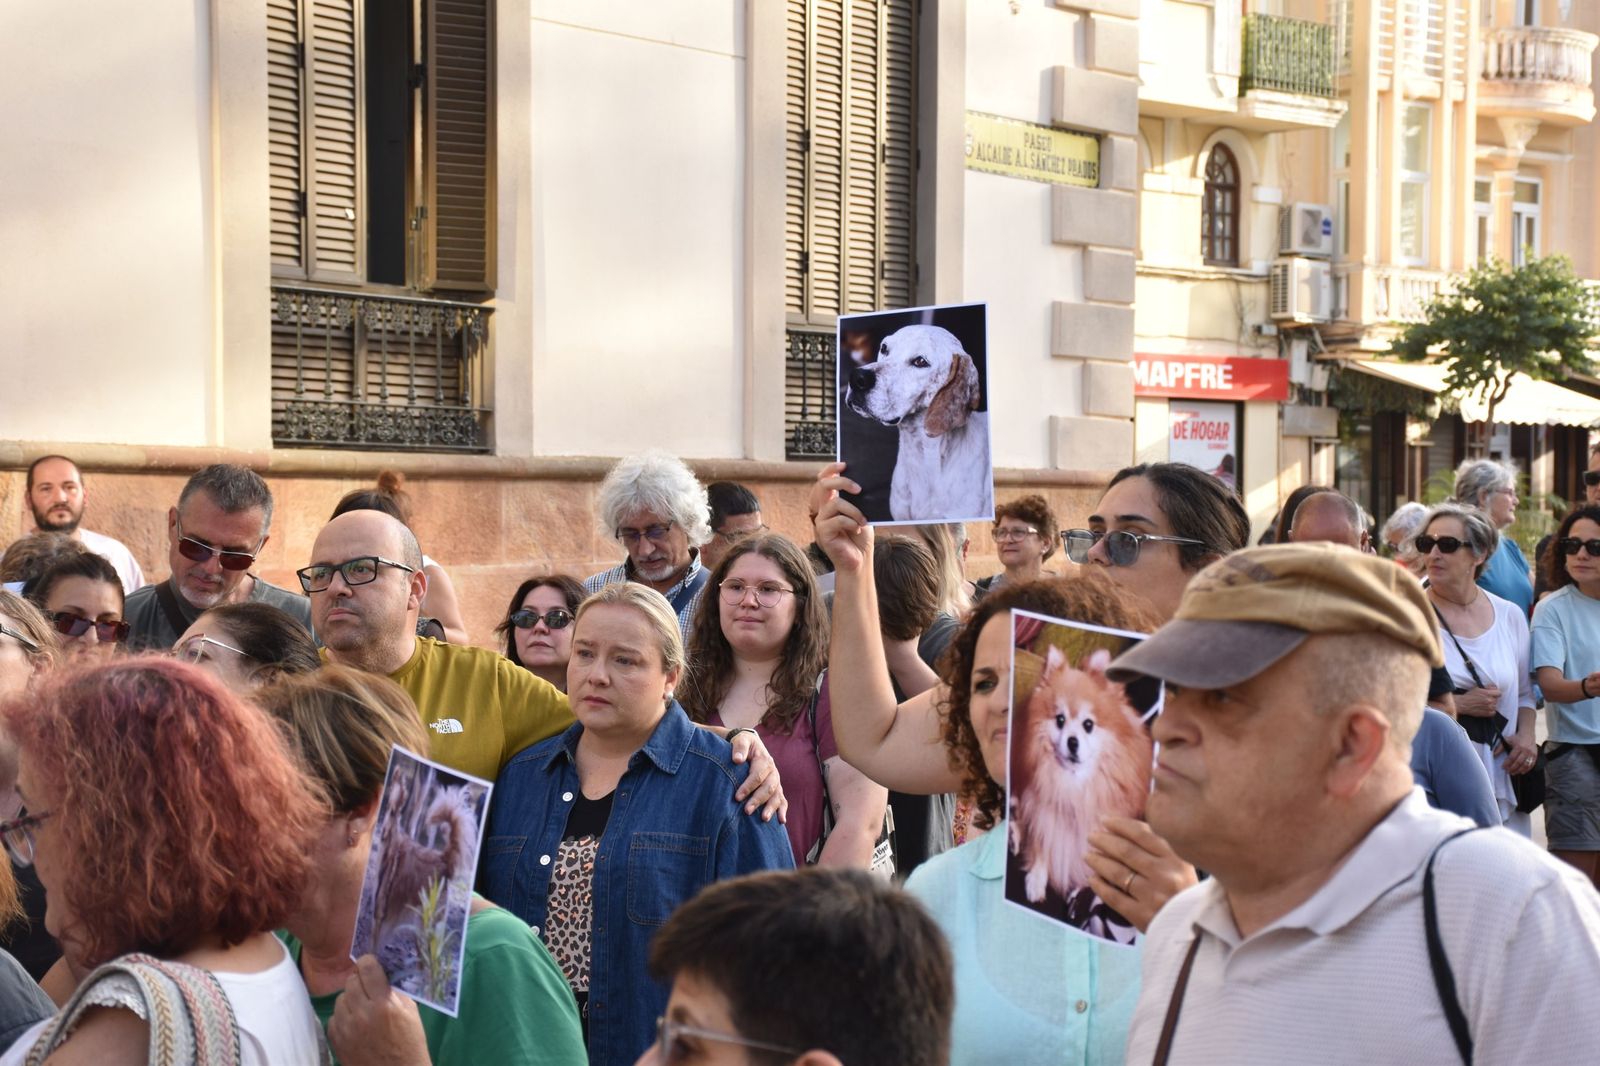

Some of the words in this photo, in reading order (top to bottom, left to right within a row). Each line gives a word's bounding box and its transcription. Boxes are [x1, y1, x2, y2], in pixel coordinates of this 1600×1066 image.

[976, 141, 1012, 166] ALCALDE
[1024, 132, 1052, 152] PASEO
[1129, 360, 1233, 390] MAPFRE
[1173, 420, 1188, 440] DE
[1190, 420, 1229, 441] HOGAR
